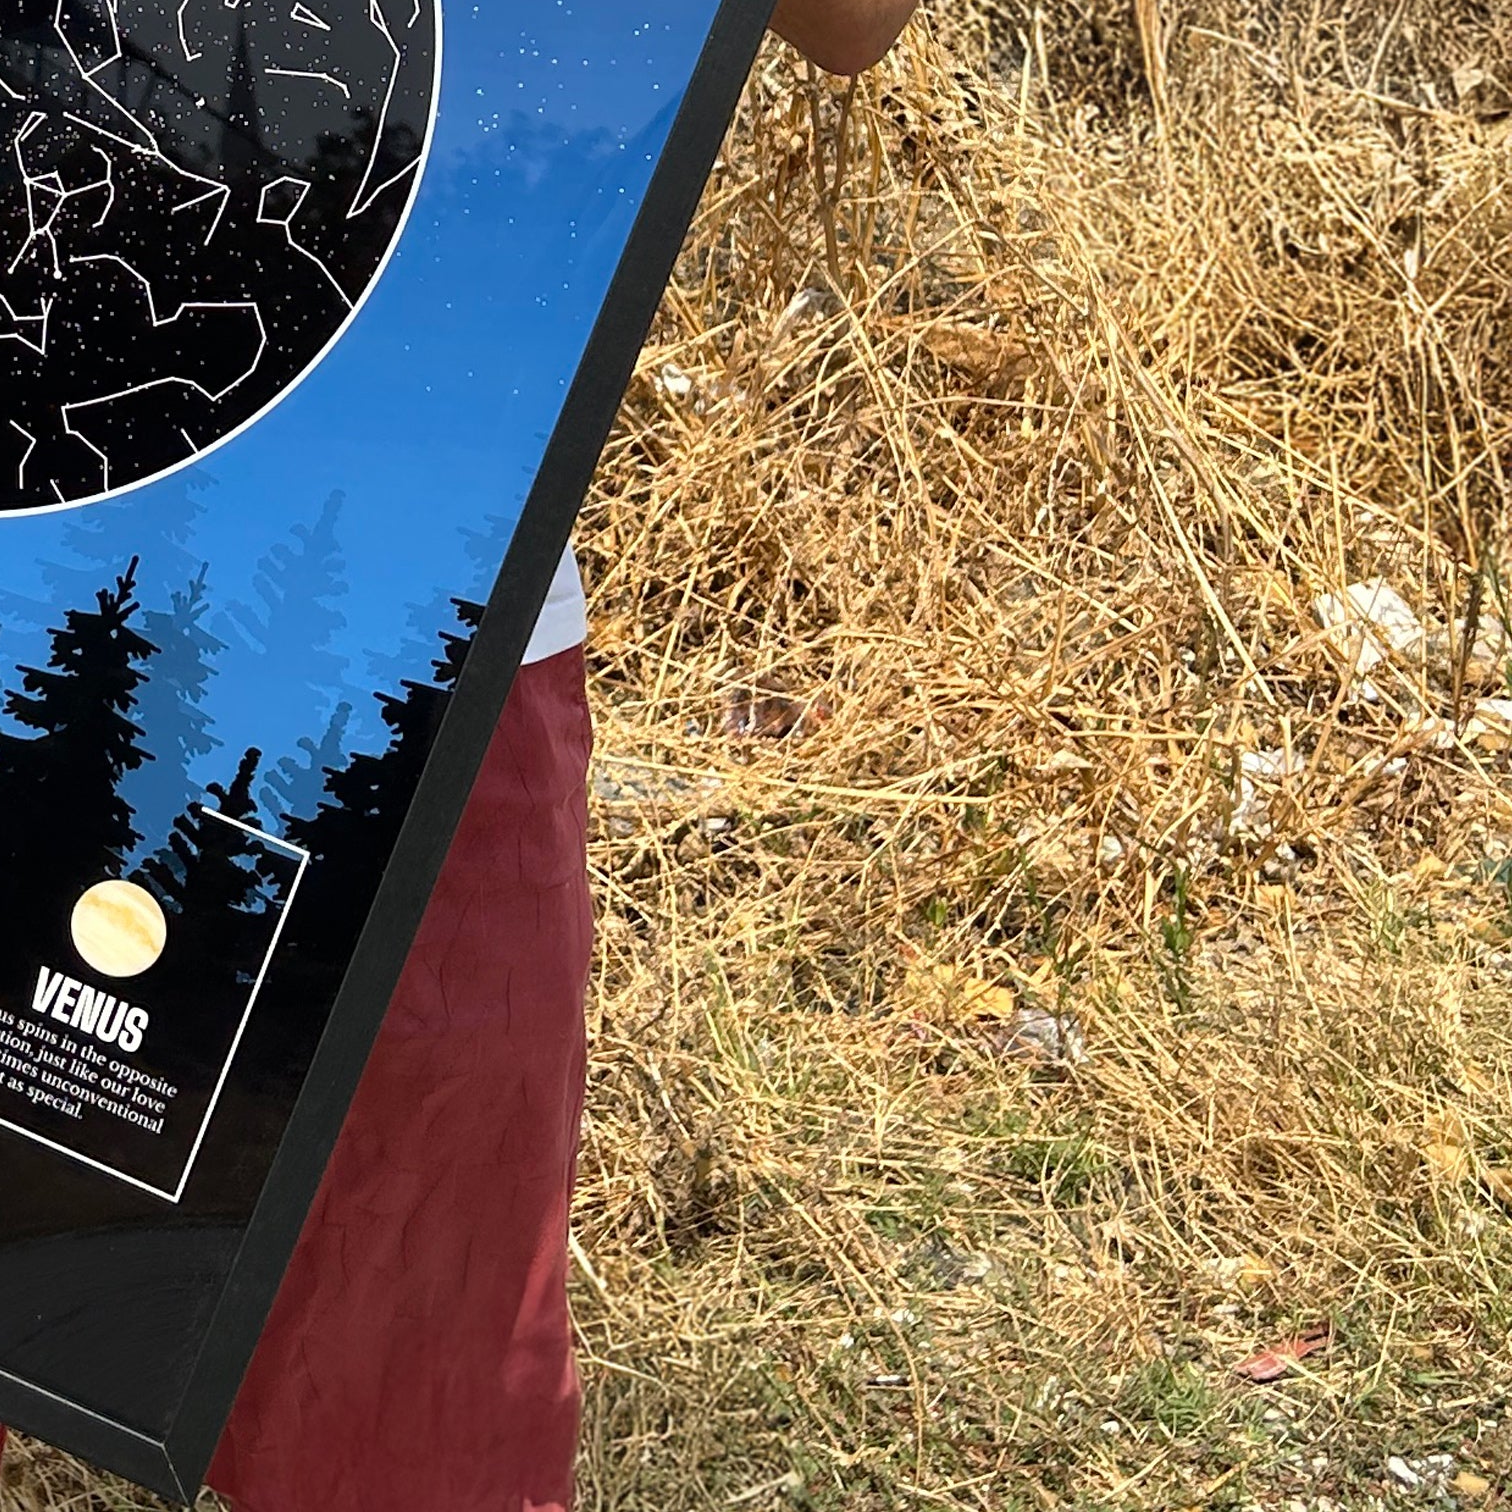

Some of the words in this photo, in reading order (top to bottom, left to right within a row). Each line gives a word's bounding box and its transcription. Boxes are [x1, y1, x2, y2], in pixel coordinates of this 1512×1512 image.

[31, 965, 148, 1052] VENUS
[16, 1019, 58, 1045] spins
[60, 1034, 77, 1054] in
[80, 1045, 107, 1066] the
[108, 1060, 177, 1098] opposite
[32, 1045, 67, 1070] just
[68, 1058, 98, 1084] like
[100, 1078, 131, 1097] our
[131, 1086, 165, 1113] love
[7, 1076, 24, 1092] as
[26, 1086, 82, 1120] special.
[41, 1070, 164, 1134] unconventional
